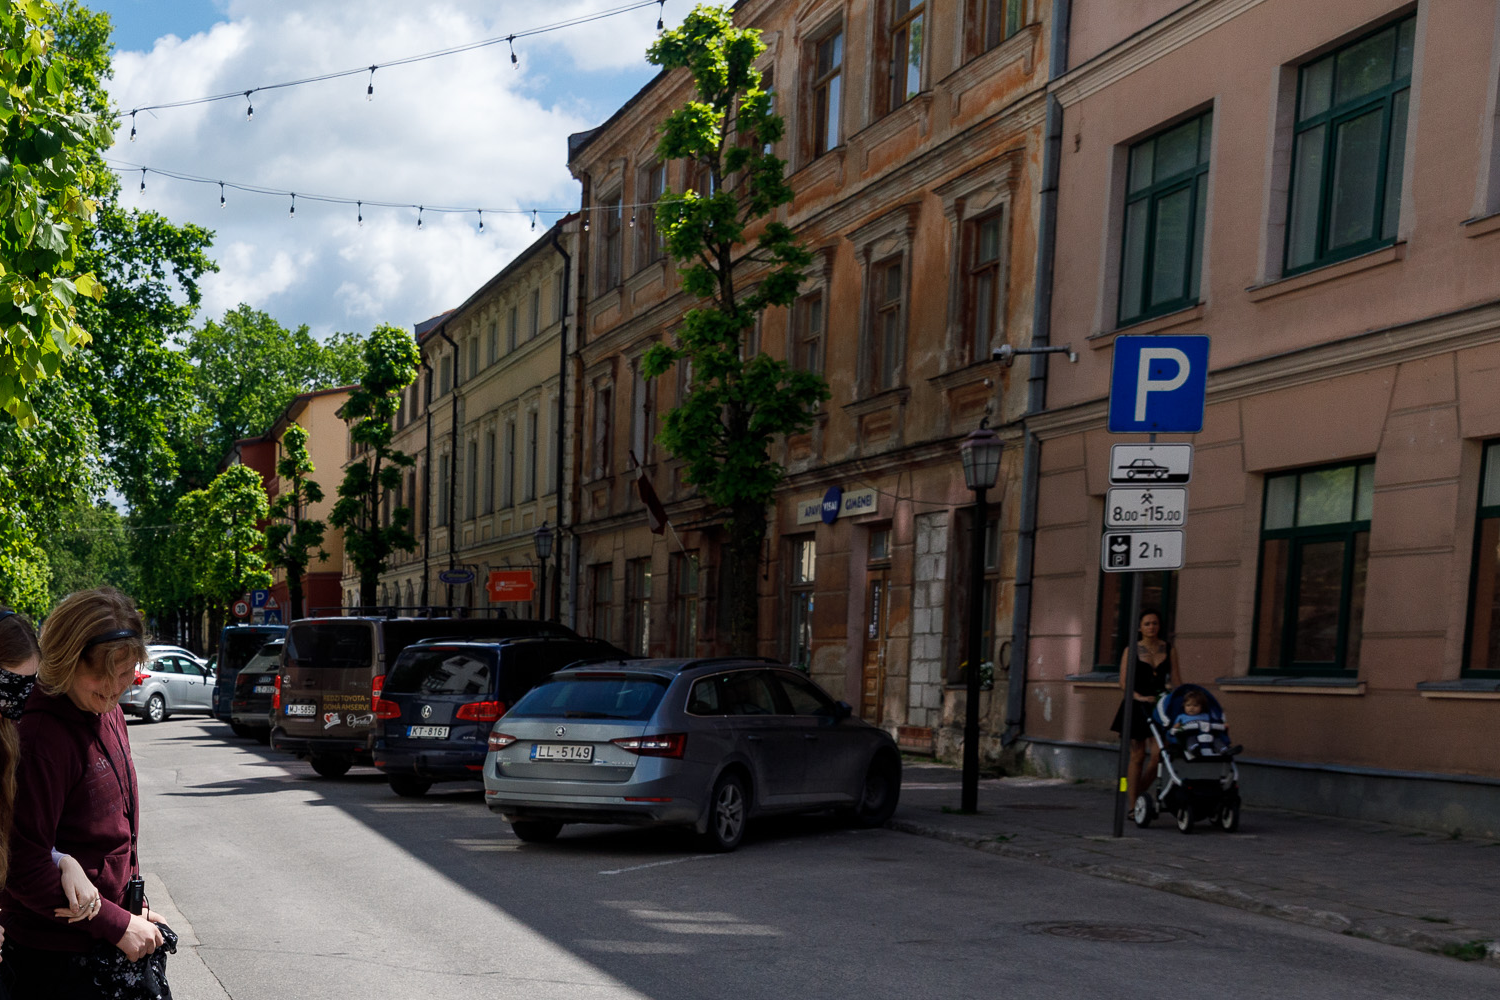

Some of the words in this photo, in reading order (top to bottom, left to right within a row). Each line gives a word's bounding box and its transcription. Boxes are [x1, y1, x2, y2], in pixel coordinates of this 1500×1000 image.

[1134, 347, 1191, 422] P
[1138, 541, 1150, 559] 2
[1153, 543, 1163, 558] h
[255, 591, 265, 606] P
[236, 604, 246, 614] 30
[411, 726, 448, 736] KT-8161
[537, 745, 591, 759] LL-5149
